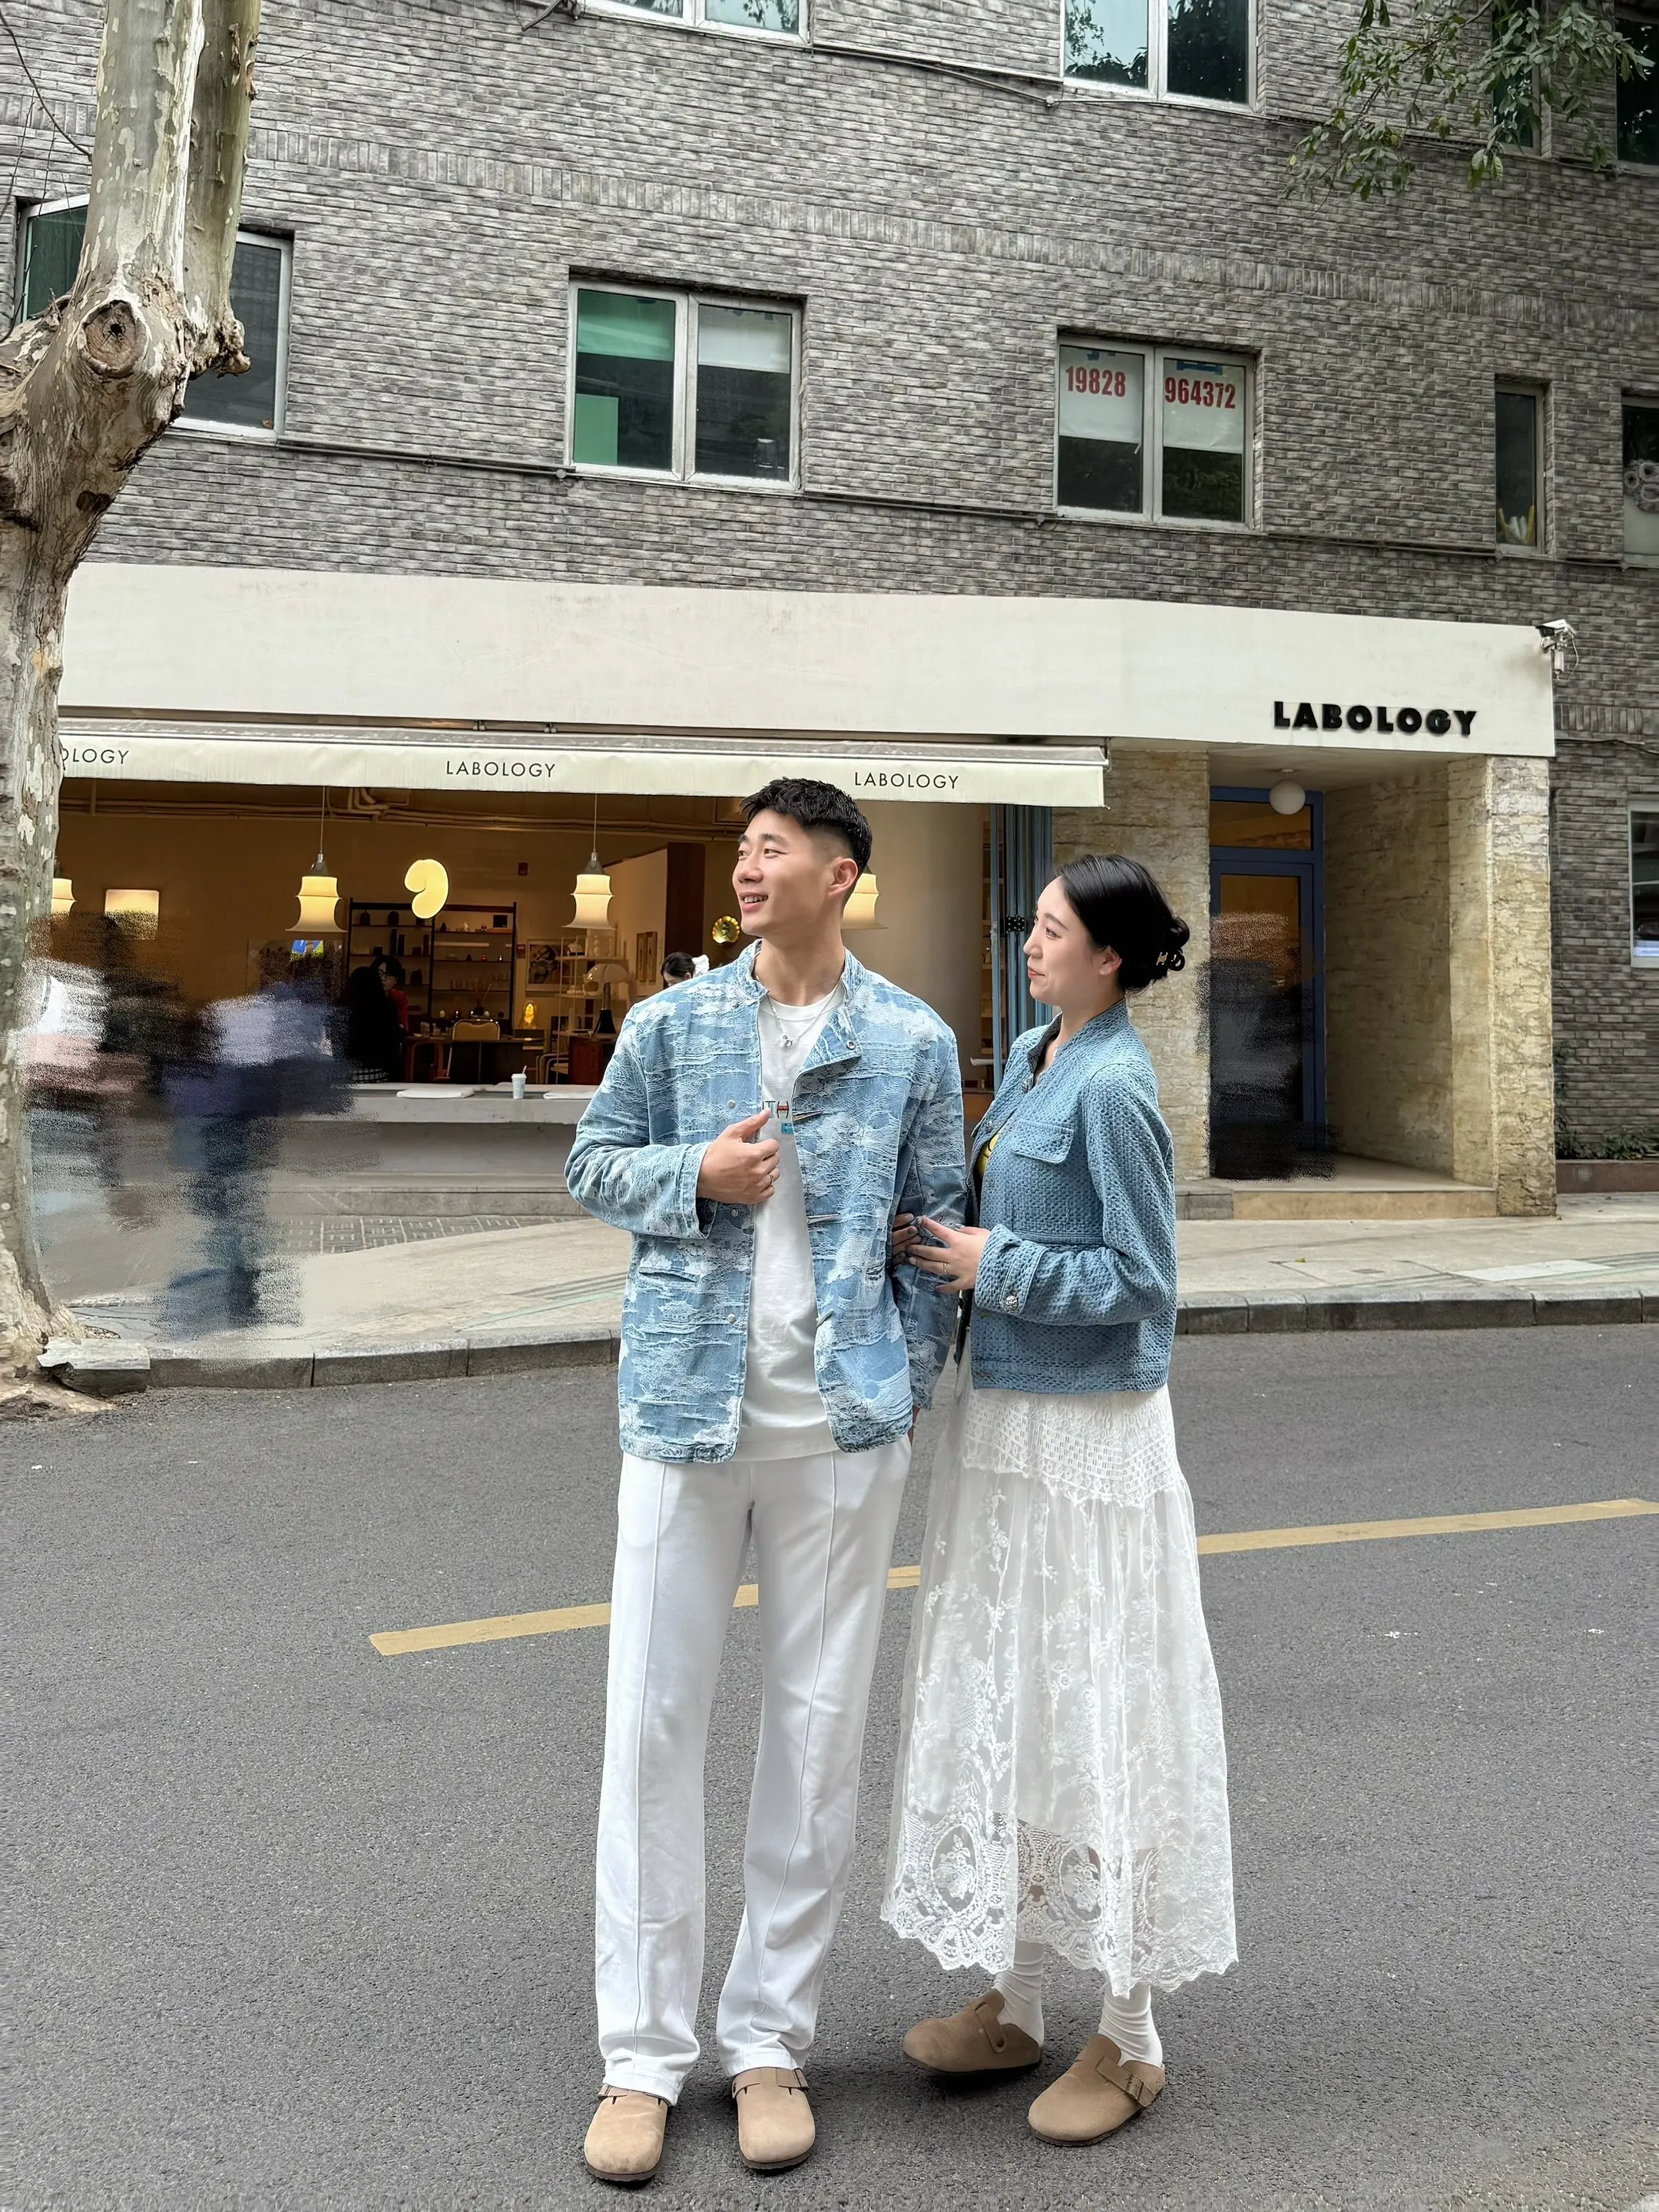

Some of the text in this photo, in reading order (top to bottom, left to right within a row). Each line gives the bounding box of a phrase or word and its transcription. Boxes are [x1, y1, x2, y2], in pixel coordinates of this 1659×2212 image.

[1065, 366, 1235, 409] 19828 964372
[1273, 700, 1477, 737] LABOLOGY
[446, 760, 555, 777] LABOLOGY
[855, 772, 959, 789] LABOLOGY
